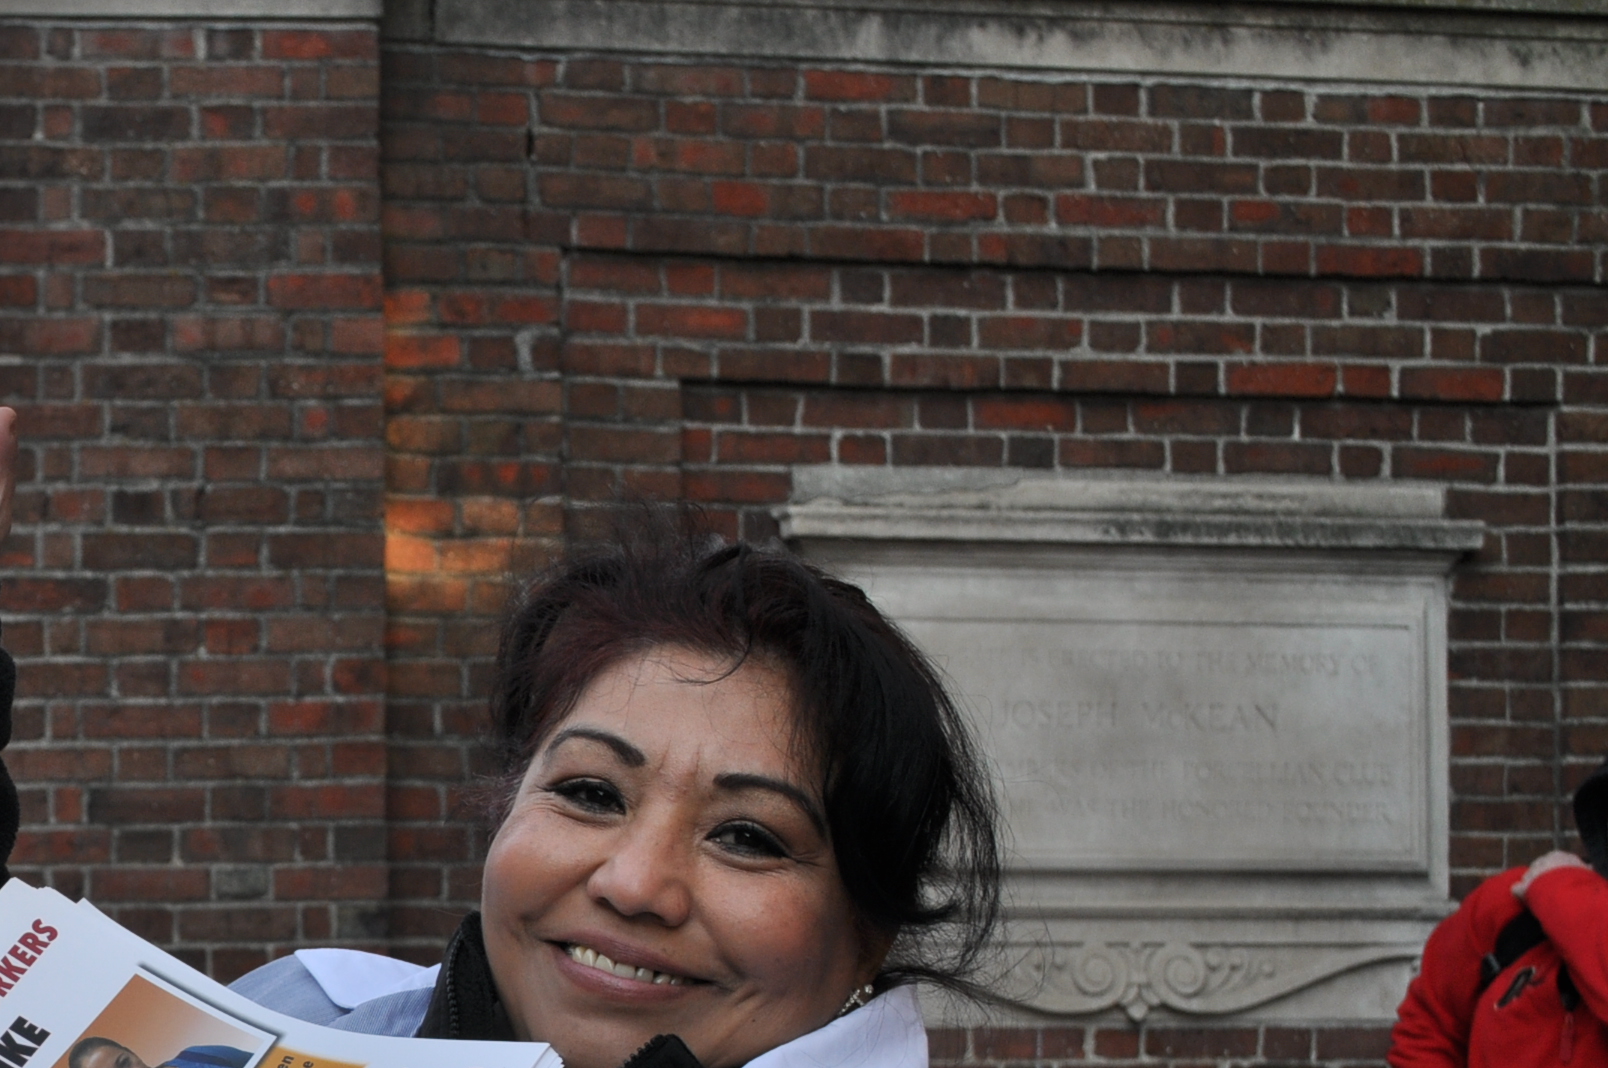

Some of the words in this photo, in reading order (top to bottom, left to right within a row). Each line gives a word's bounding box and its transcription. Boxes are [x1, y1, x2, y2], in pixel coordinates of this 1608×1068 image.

[1246, 652, 1340, 676] MEMORY
[995, 700, 1118, 728] JOSEPH
[1141, 701, 1279, 733] McKEAN
[1334, 762, 1393, 788] CLUB
[1282, 801, 1394, 826] FOUNDER
